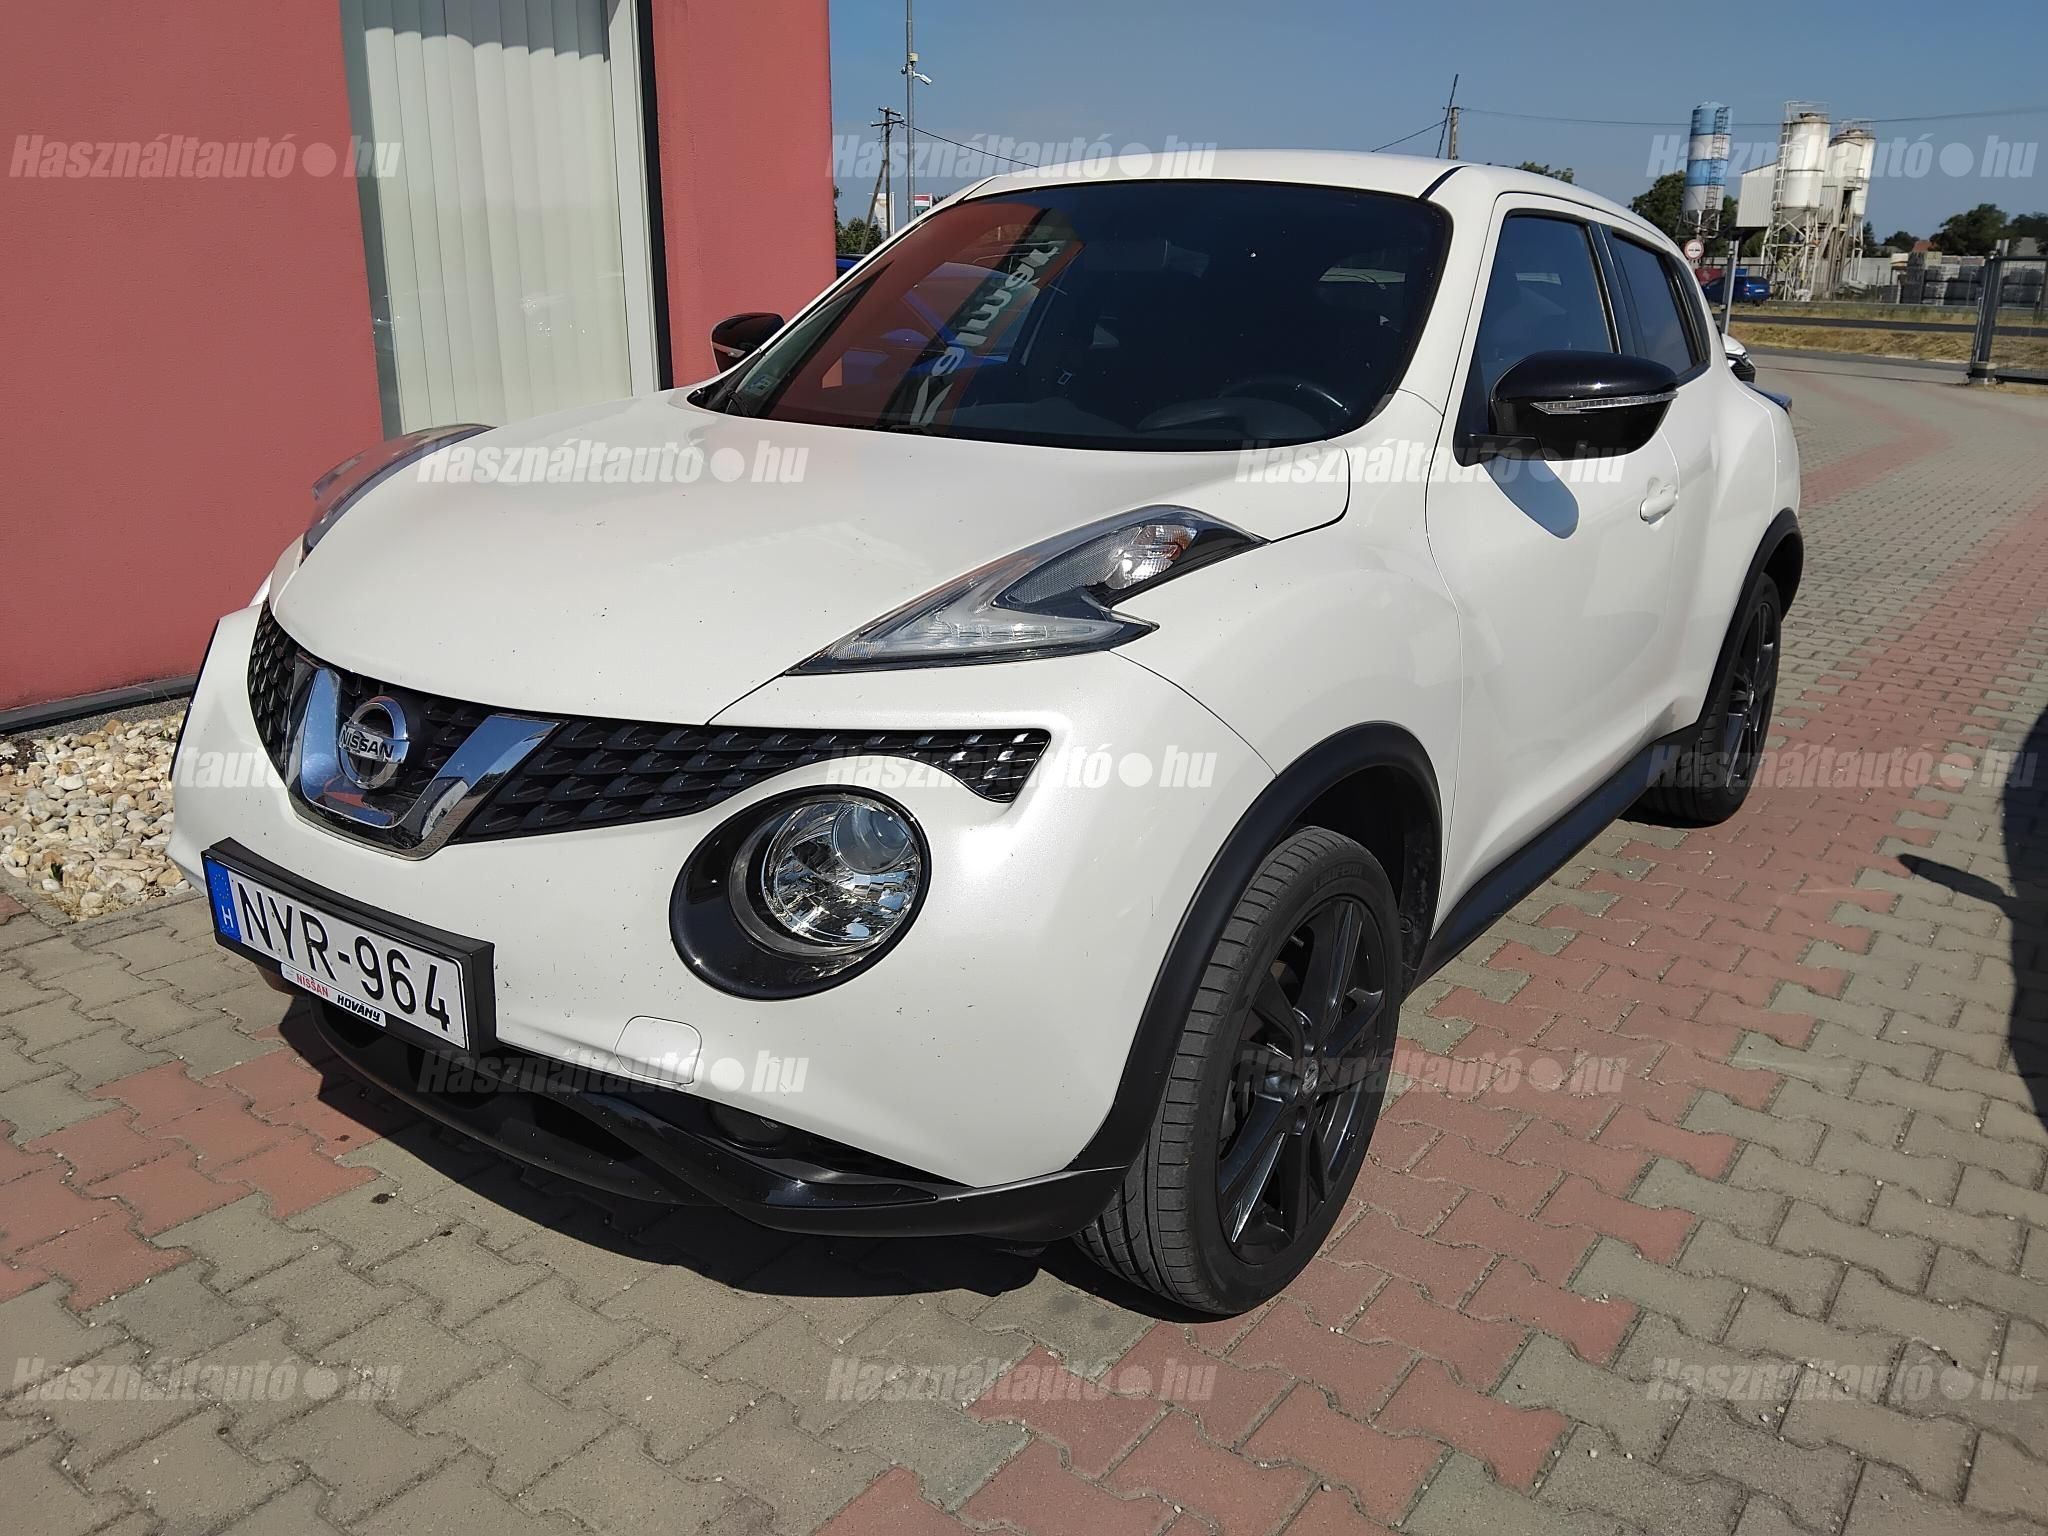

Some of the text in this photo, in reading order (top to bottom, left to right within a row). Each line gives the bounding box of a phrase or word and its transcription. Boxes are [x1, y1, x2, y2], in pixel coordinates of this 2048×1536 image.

[340, 727, 394, 759] NISSAN
[219, 904, 233, 930] H
[236, 881, 451, 1034] NYR-964
[296, 973, 330, 999] NISSAN
